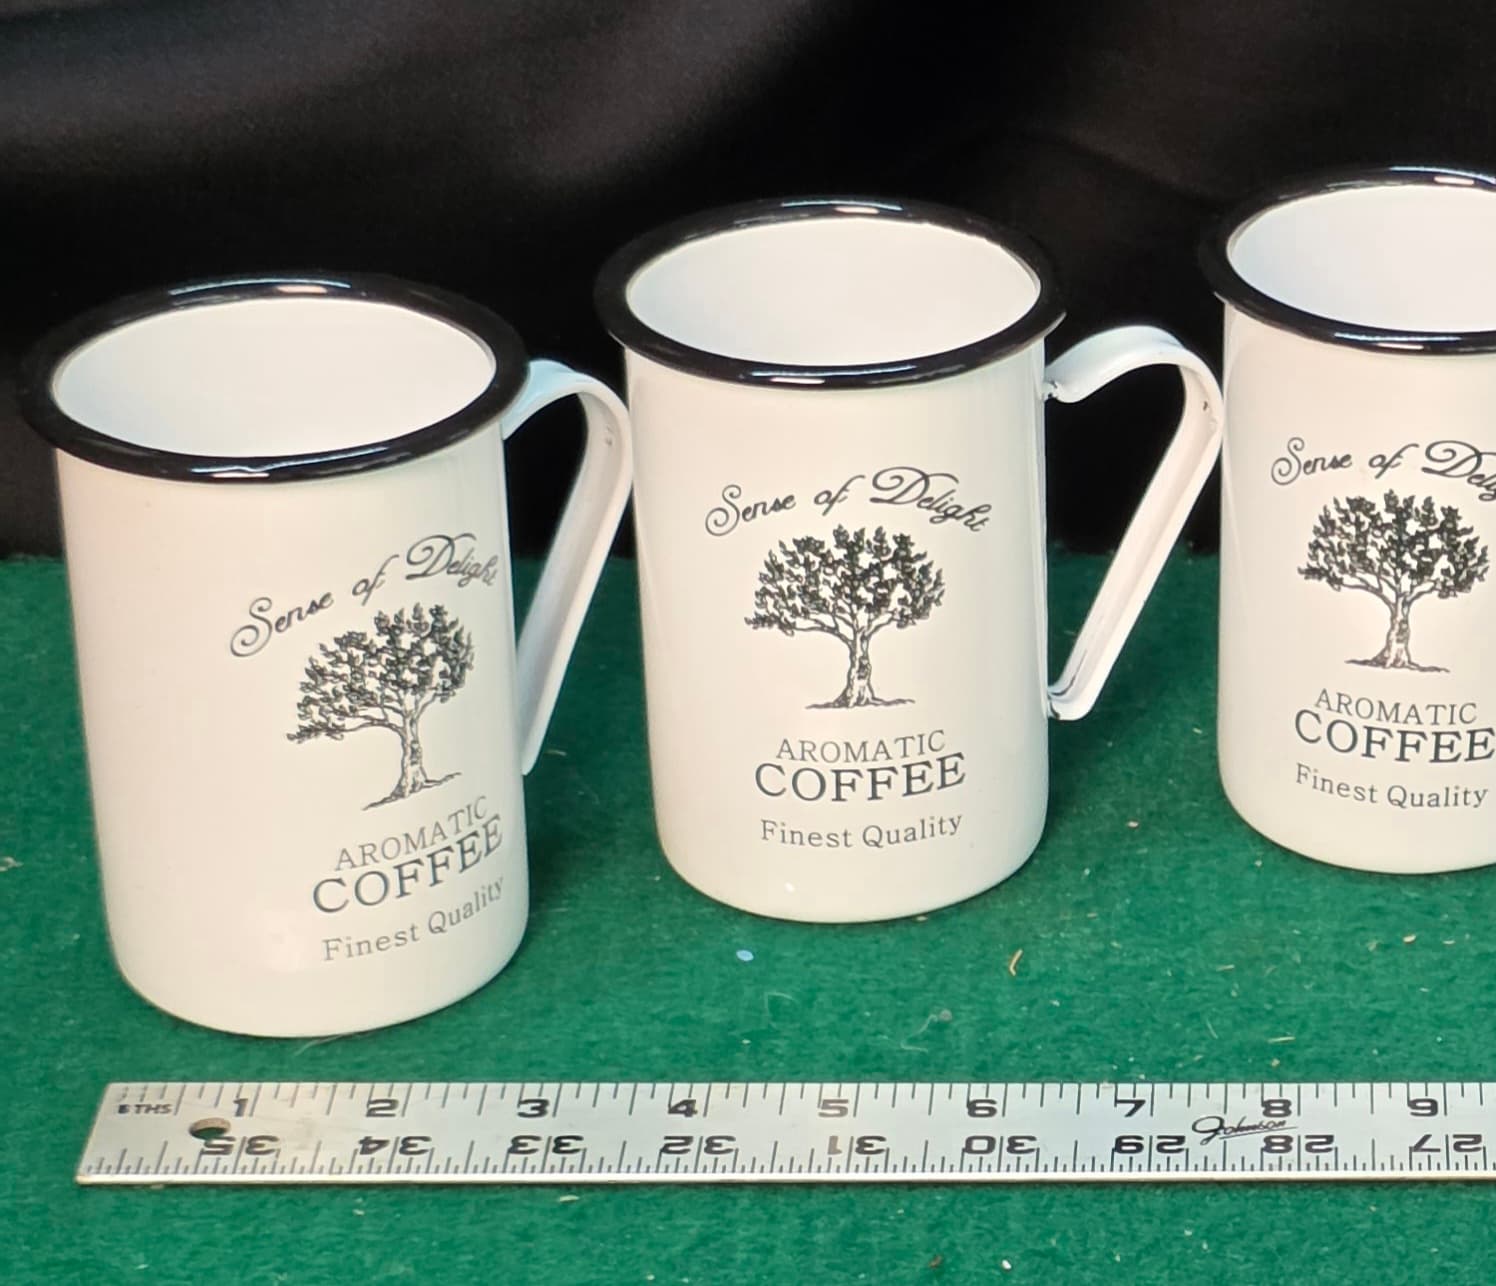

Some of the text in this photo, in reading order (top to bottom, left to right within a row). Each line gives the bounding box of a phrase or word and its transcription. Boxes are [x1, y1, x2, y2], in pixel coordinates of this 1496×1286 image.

[1271, 437, 1353, 486] Sense
[1368, 443, 1419, 479] of
[705, 466, 992, 537] Sense of Delight
[230, 533, 498, 658] Sense of Delight
[1314, 688, 1478, 726] AROMATIC
[776, 729, 946, 764] AROMATIC
[1295, 708, 1496, 764] COFFEE
[755, 751, 966, 802] COFFEE
[1295, 762, 1489, 809] Finest Quality
[335, 795, 487, 872] AROMATIC
[760, 813, 962, 849] Finest Quality
[313, 814, 503, 912] COFFEE
[323, 876, 504, 962] Finest Quality
[233, 1099, 249, 1117] 1
[366, 1099, 399, 1117] 2
[517, 1099, 550, 1118] 3
[668, 1099, 698, 1118] 4
[818, 1099, 849, 1118] 5
[967, 1099, 997, 1118] 6
[1116, 1099, 1146, 1117] 7
[1262, 1099, 1292, 1118] 8
[1408, 1099, 1439, 1116] 9
[1192, 1116, 1286, 1145] Johnson
